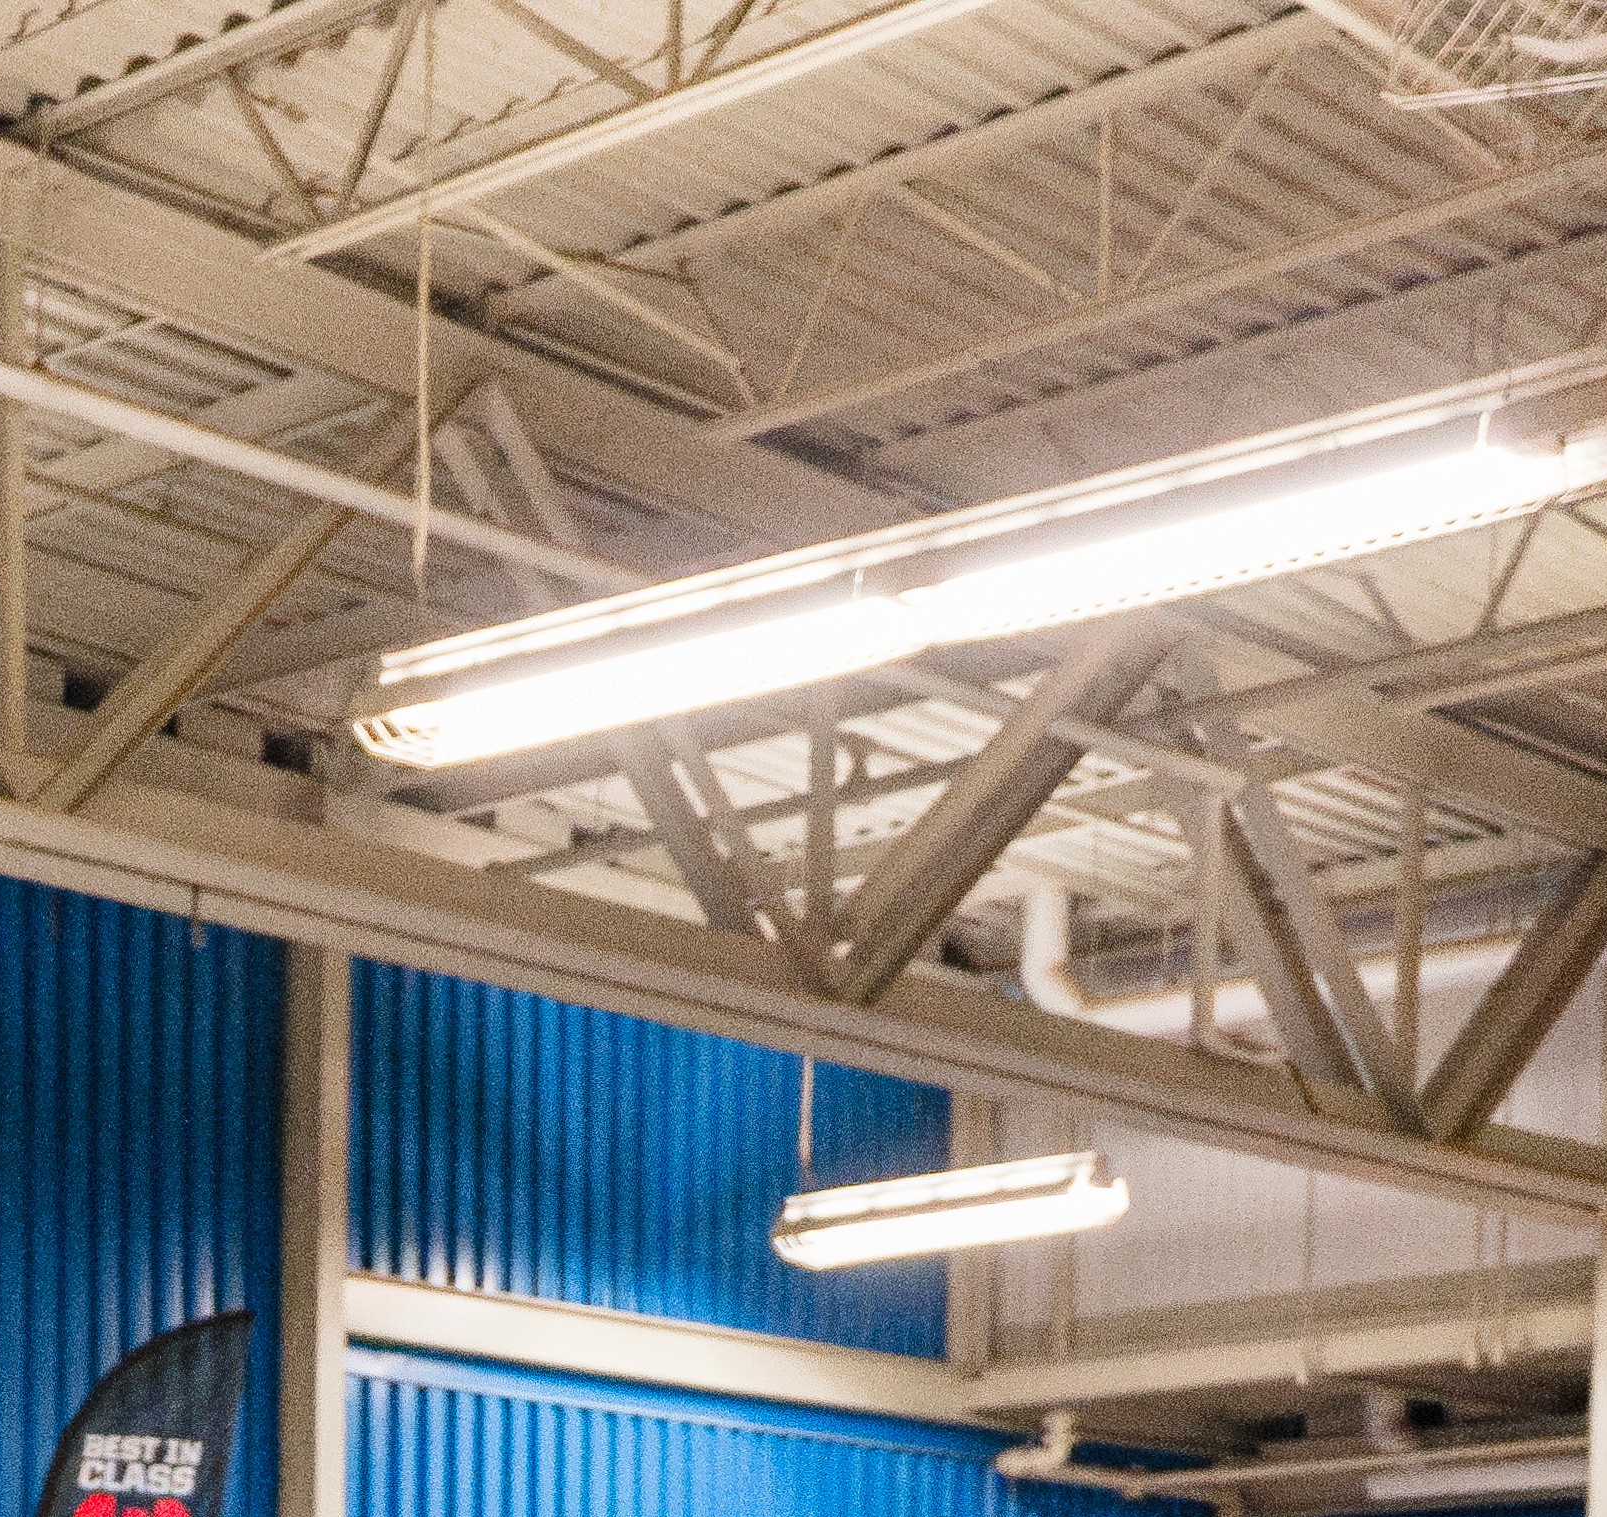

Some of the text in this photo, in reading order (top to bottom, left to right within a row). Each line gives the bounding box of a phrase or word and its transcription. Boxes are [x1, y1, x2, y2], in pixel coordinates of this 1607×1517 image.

[83, 1434, 202, 1465] BEST IN
[77, 1464, 198, 1497] CLASS
